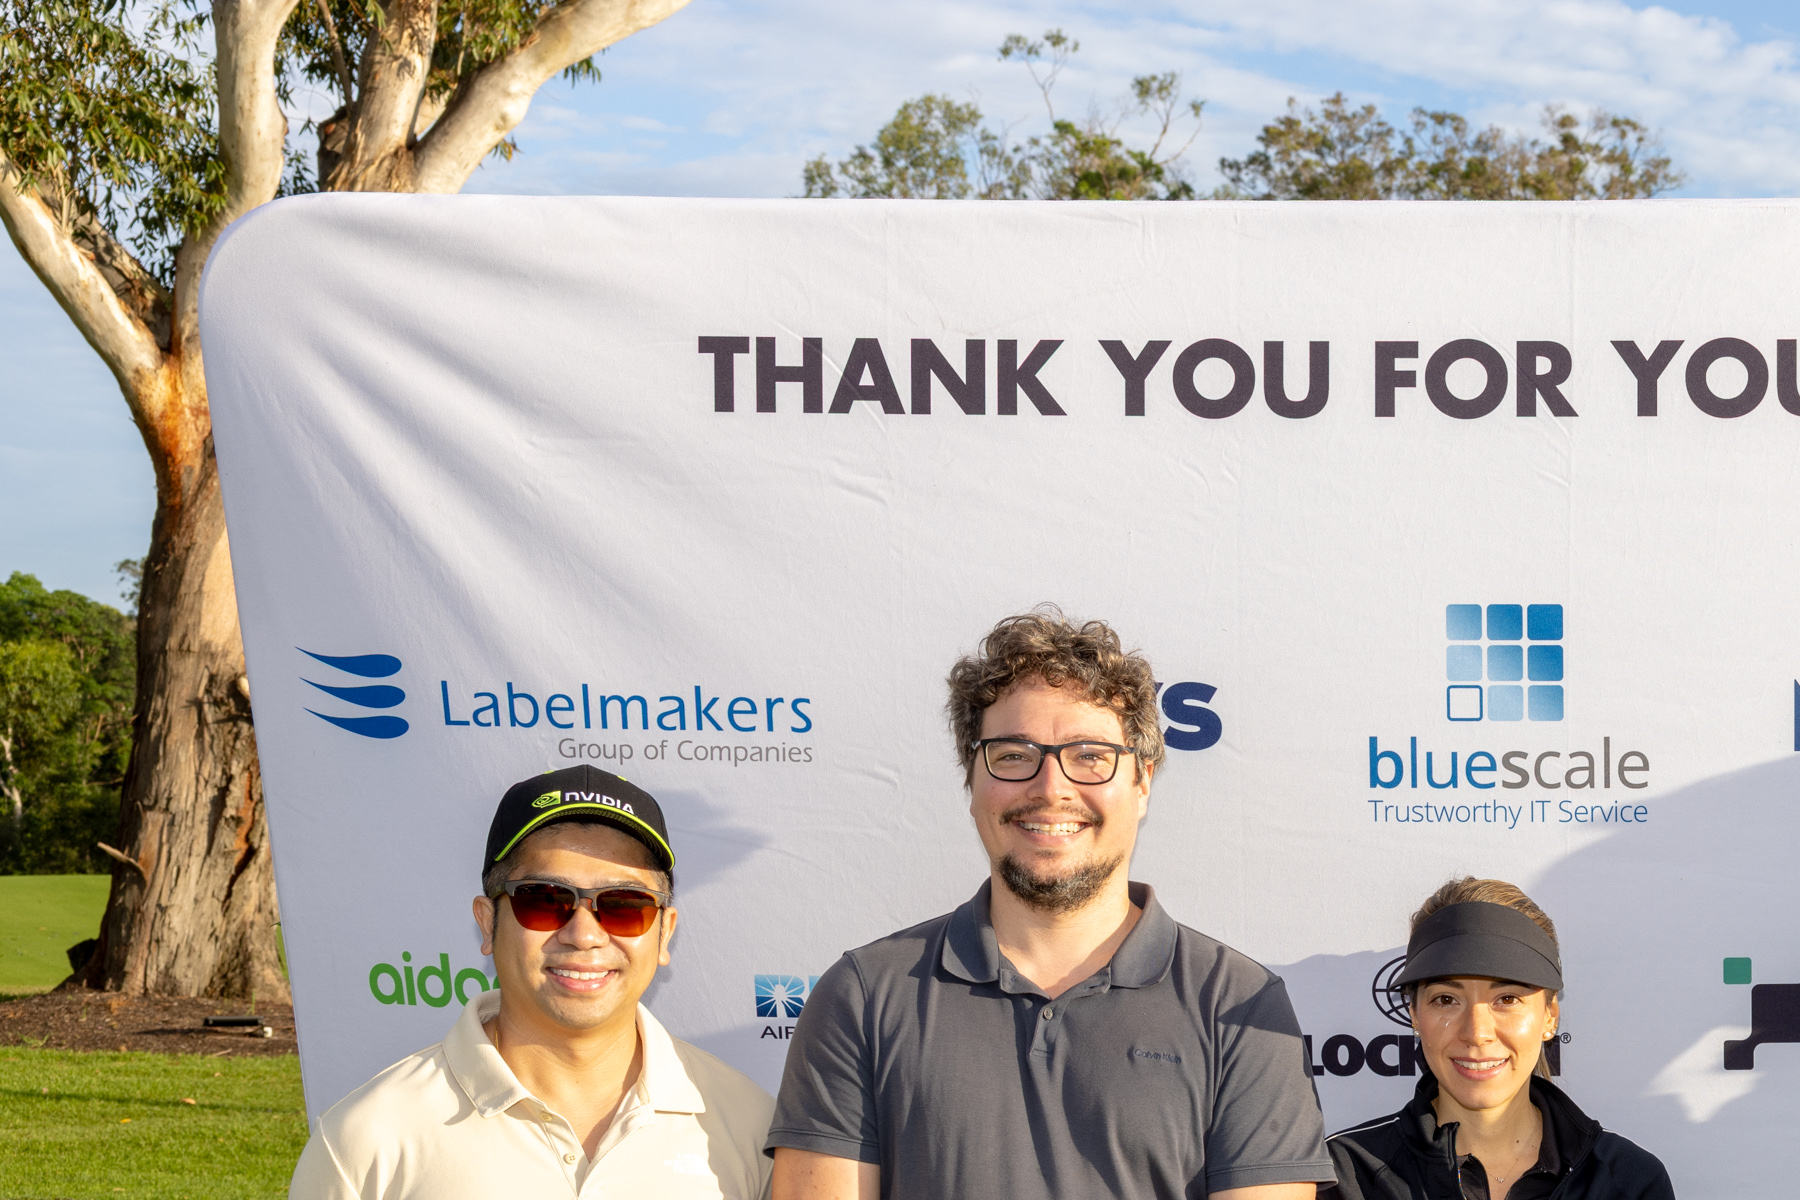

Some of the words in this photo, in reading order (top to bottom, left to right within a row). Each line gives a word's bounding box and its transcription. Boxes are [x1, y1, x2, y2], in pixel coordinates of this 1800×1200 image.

[697, 335, 1068, 416] THANK
[1098, 337, 1330, 420] YOU
[1374, 337, 1579, 420] FOR
[440, 680, 813, 734] Labelmakers
[558, 738, 634, 765] Group
[643, 740, 669, 760] of
[677, 740, 814, 767] Companies
[1368, 736, 1650, 790] bluescale
[1367, 799, 1523, 830] Trustworthy
[1530, 800, 1552, 823] IT
[1558, 800, 1649, 823] Service
[369, 951, 500, 1008] aido
